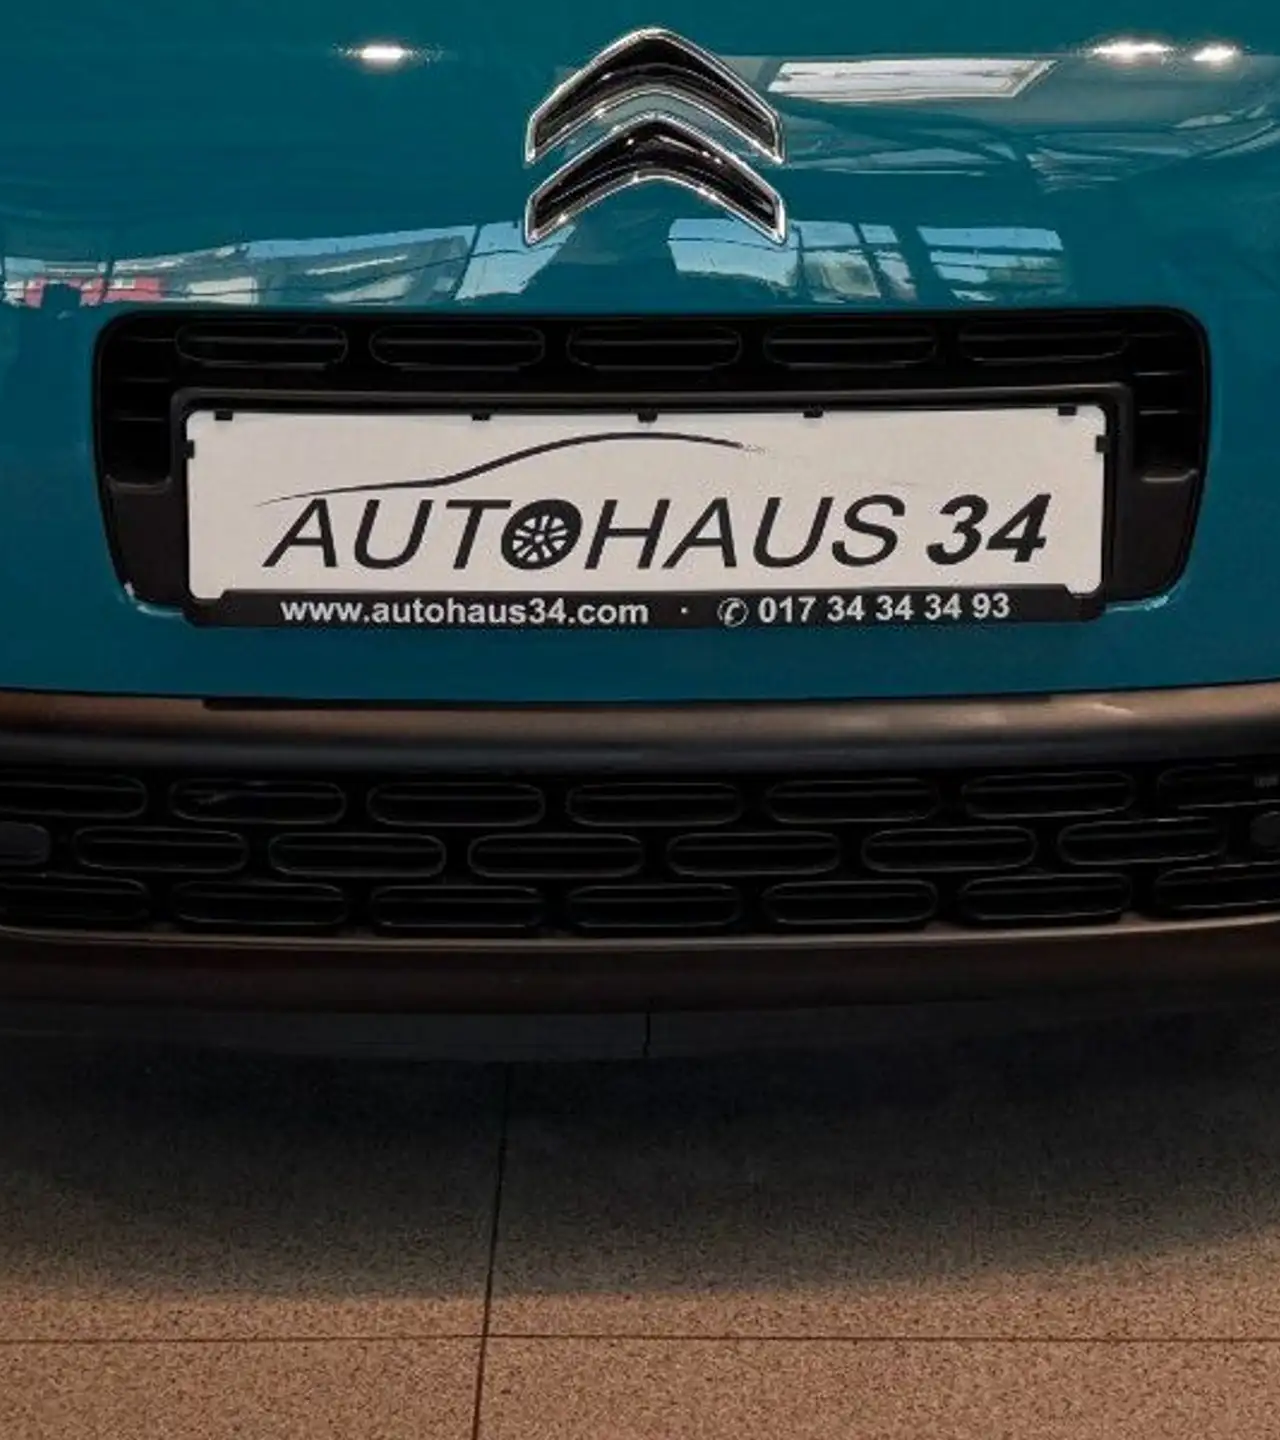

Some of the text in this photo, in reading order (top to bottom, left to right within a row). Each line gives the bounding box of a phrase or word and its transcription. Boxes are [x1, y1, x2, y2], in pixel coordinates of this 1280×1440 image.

[261, 494, 1052, 569] AUTOHAUS 34
[280, 592, 1011, 625] www.autohaus34.com 017 34 34 34 93
